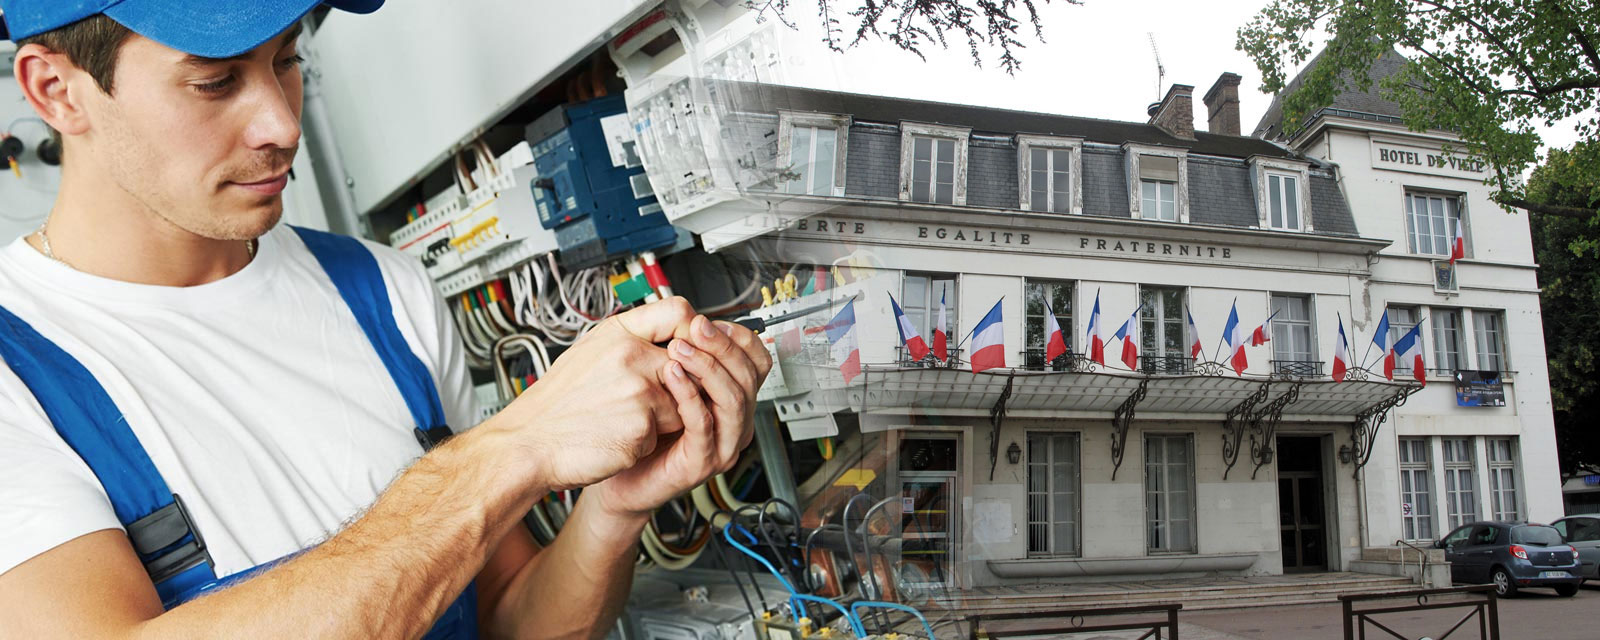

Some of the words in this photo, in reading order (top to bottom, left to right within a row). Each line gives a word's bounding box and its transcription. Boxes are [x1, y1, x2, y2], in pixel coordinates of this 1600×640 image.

[1379, 148, 1422, 166] HOTEL
[743, 215, 865, 234] LIBERTE
[918, 226, 1031, 245] EGALITE
[1079, 237, 1232, 259] FRATERNITE
